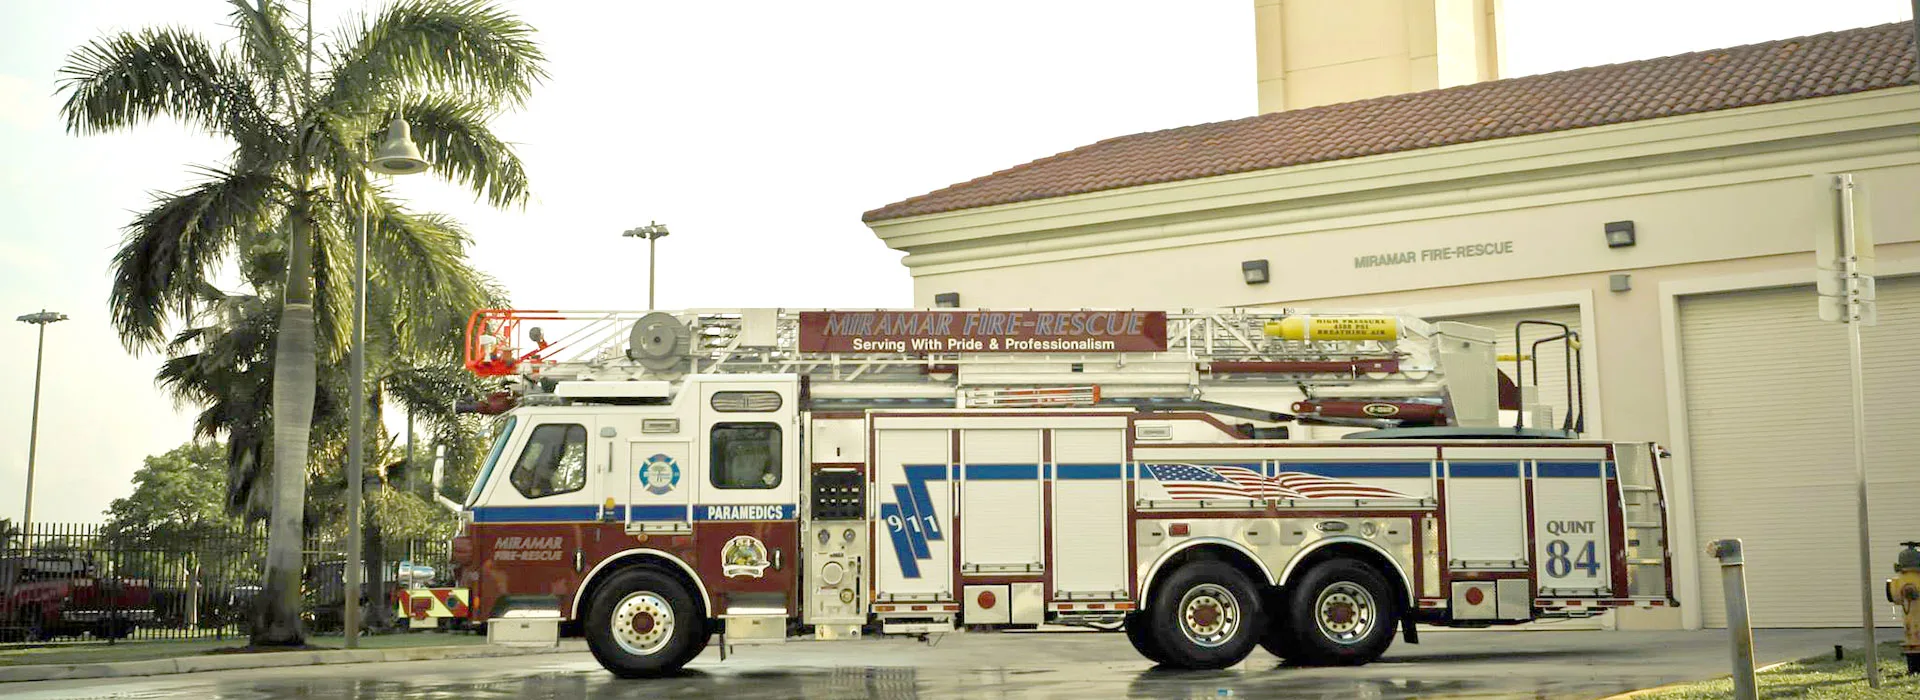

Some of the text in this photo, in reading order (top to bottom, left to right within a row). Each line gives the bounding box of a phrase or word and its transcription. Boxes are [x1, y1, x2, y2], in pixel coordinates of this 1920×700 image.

[1354, 241, 1514, 269] MIRAMAR FIRE-RESCUE
[823, 312, 1145, 336] MIRAMAR FIRE-RESCUE
[853, 338, 1115, 352] Serving With Pride & Professionalism
[707, 505, 783, 520] PARAMEDICS
[887, 514, 938, 533] 911
[1546, 520, 1596, 536] QUINT
[494, 536, 563, 549] MIRAMAR
[494, 550, 563, 561] FIRE-RESCUE
[1545, 540, 1600, 578] 84
